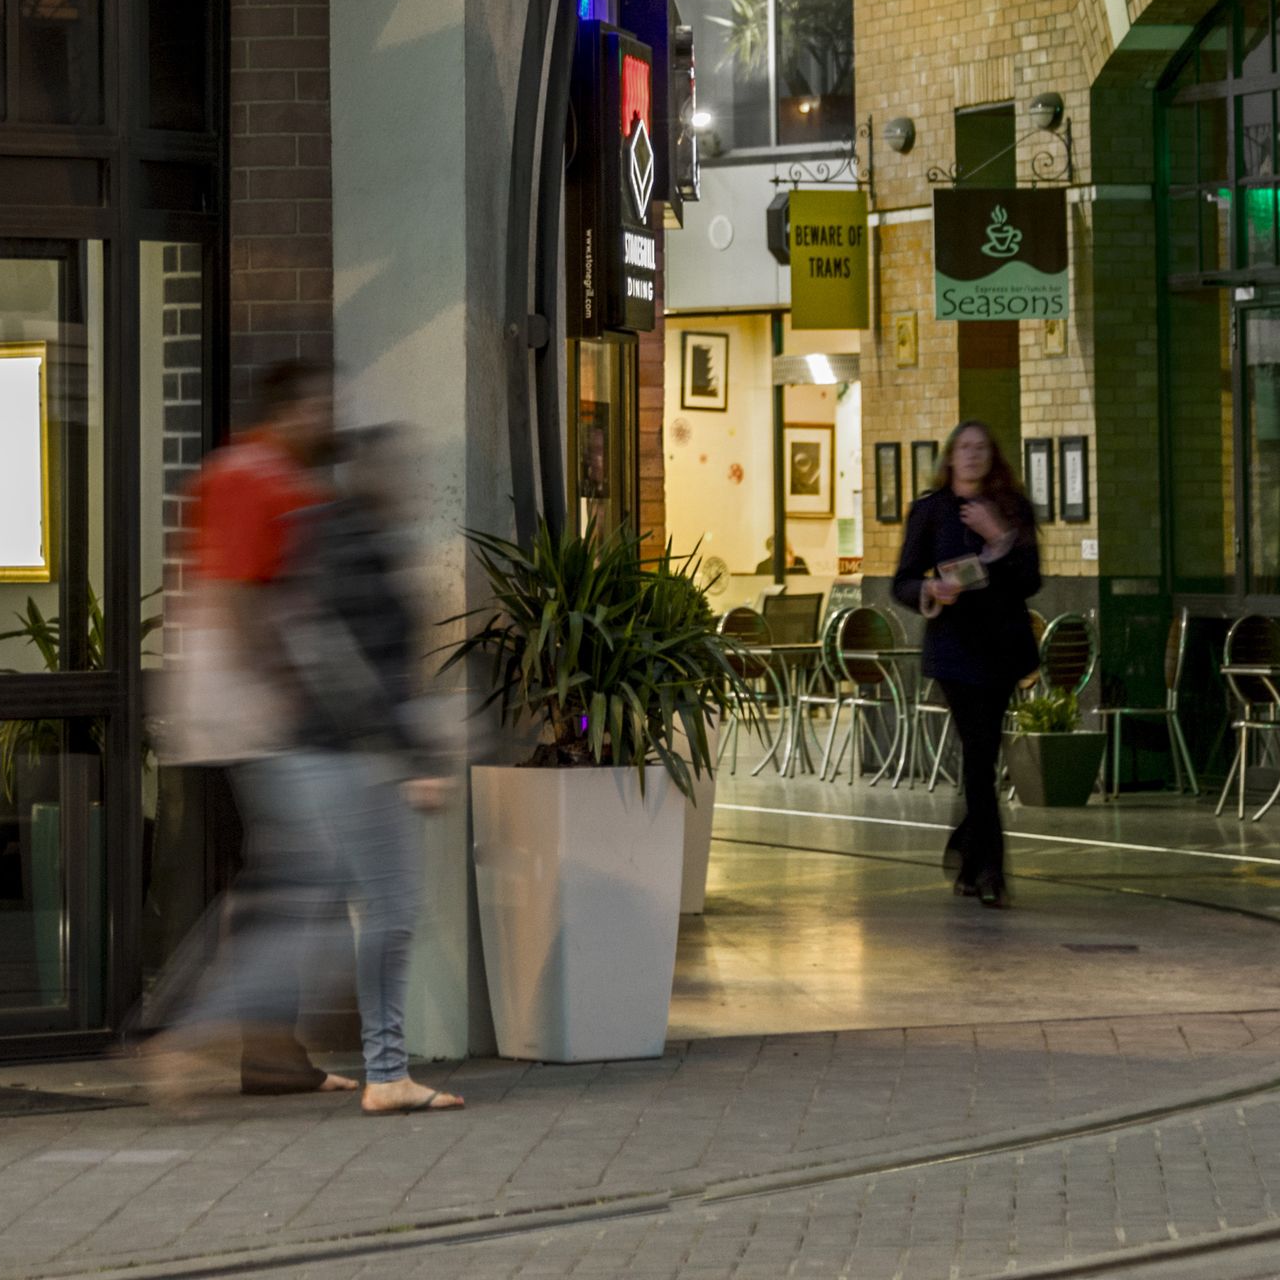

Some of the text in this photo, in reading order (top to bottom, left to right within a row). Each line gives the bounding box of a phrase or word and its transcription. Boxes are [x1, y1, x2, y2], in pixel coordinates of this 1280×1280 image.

[795, 225, 863, 247] BEWARE OF
[583, 228, 594, 319] www.stonegrill.com
[808, 256, 851, 278] TRAMS
[627, 276, 654, 301] DINING
[942, 288, 1063, 317] Seasons
